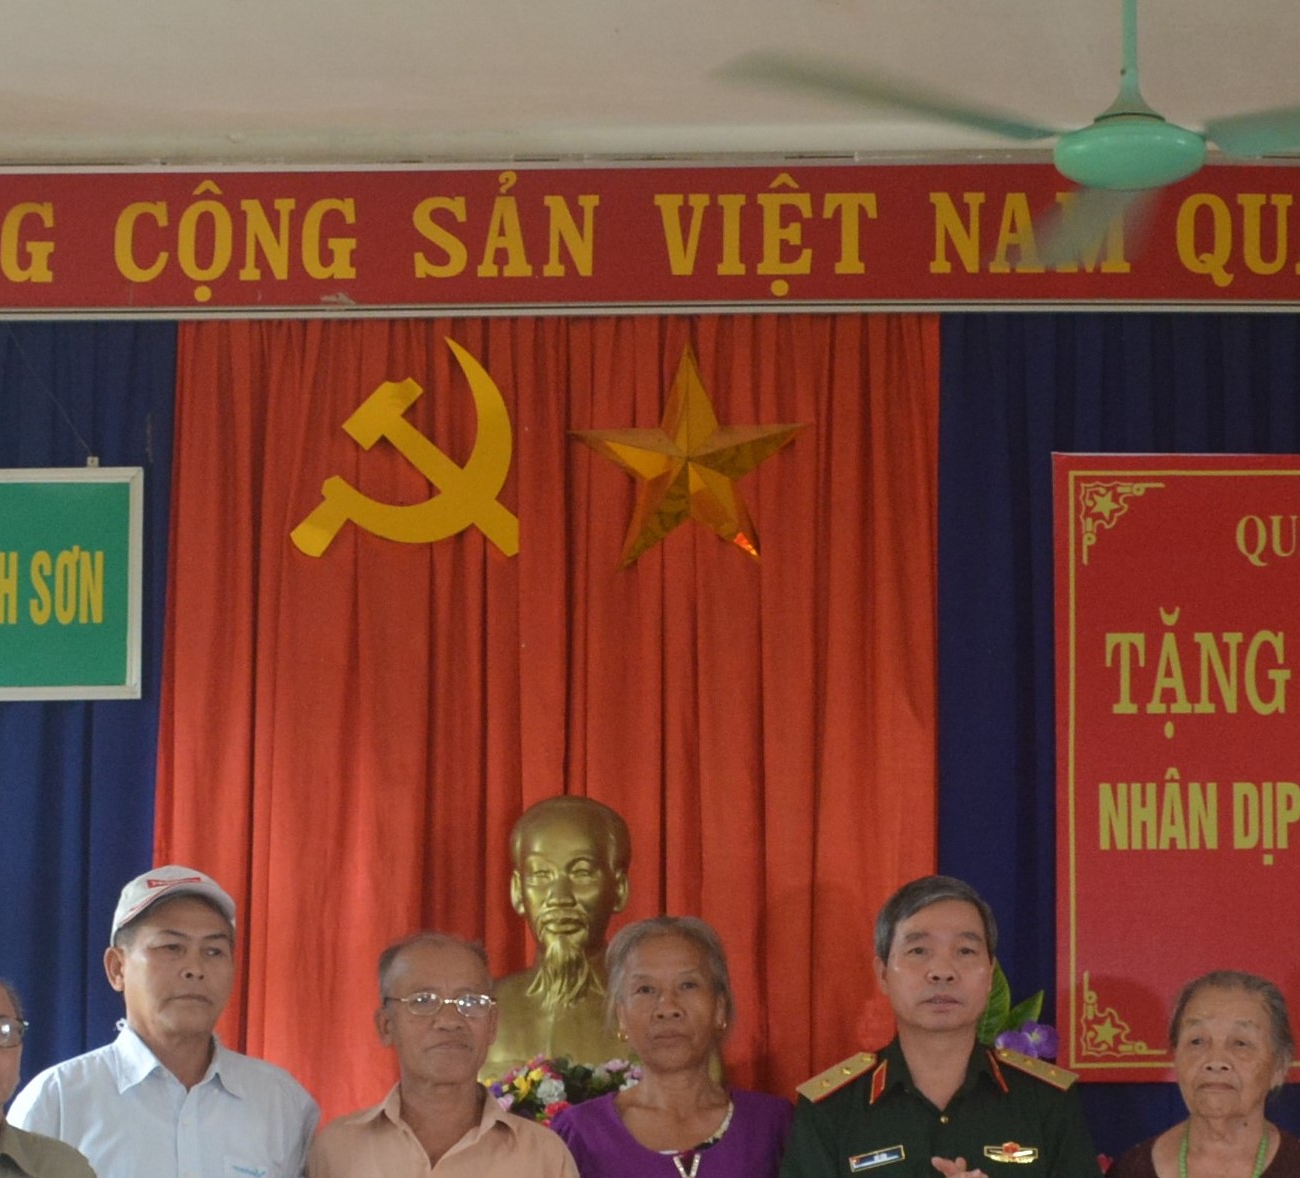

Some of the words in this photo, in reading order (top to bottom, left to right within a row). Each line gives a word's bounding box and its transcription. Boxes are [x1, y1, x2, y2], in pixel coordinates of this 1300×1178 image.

[113, 179, 358, 303] CỘNG
[412, 169, 601, 280] SẢN
[653, 172, 879, 298] VIỆT
[29, 545, 104, 625] SƠN
[1105, 606, 1292, 740] TẶNG
[1098, 767, 1219, 851] NHÂN
